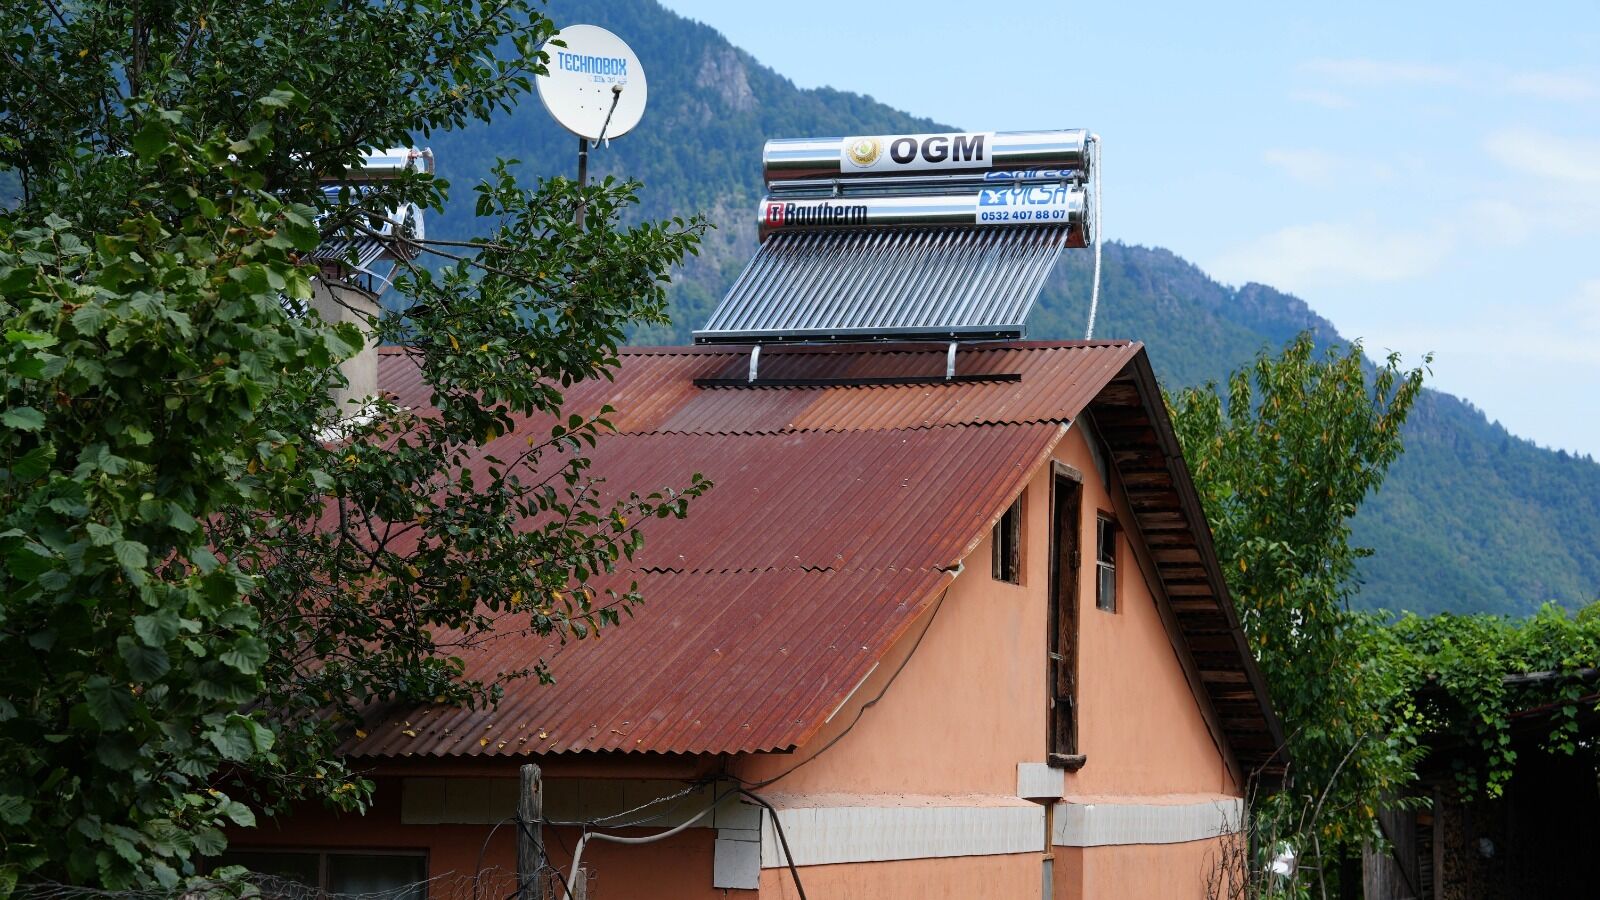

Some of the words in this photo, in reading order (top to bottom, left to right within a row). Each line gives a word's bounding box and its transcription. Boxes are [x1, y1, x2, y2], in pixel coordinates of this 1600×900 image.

[557, 52, 627, 76] TECHNOBOX
[890, 135, 985, 164] OGM
[785, 202, 868, 226] Bautherm
[981, 211, 1009, 221] 0532
[1012, 210, 1033, 220] 407
[1035, 210, 1050, 219] 88
[1052, 210, 1066, 219] 07
